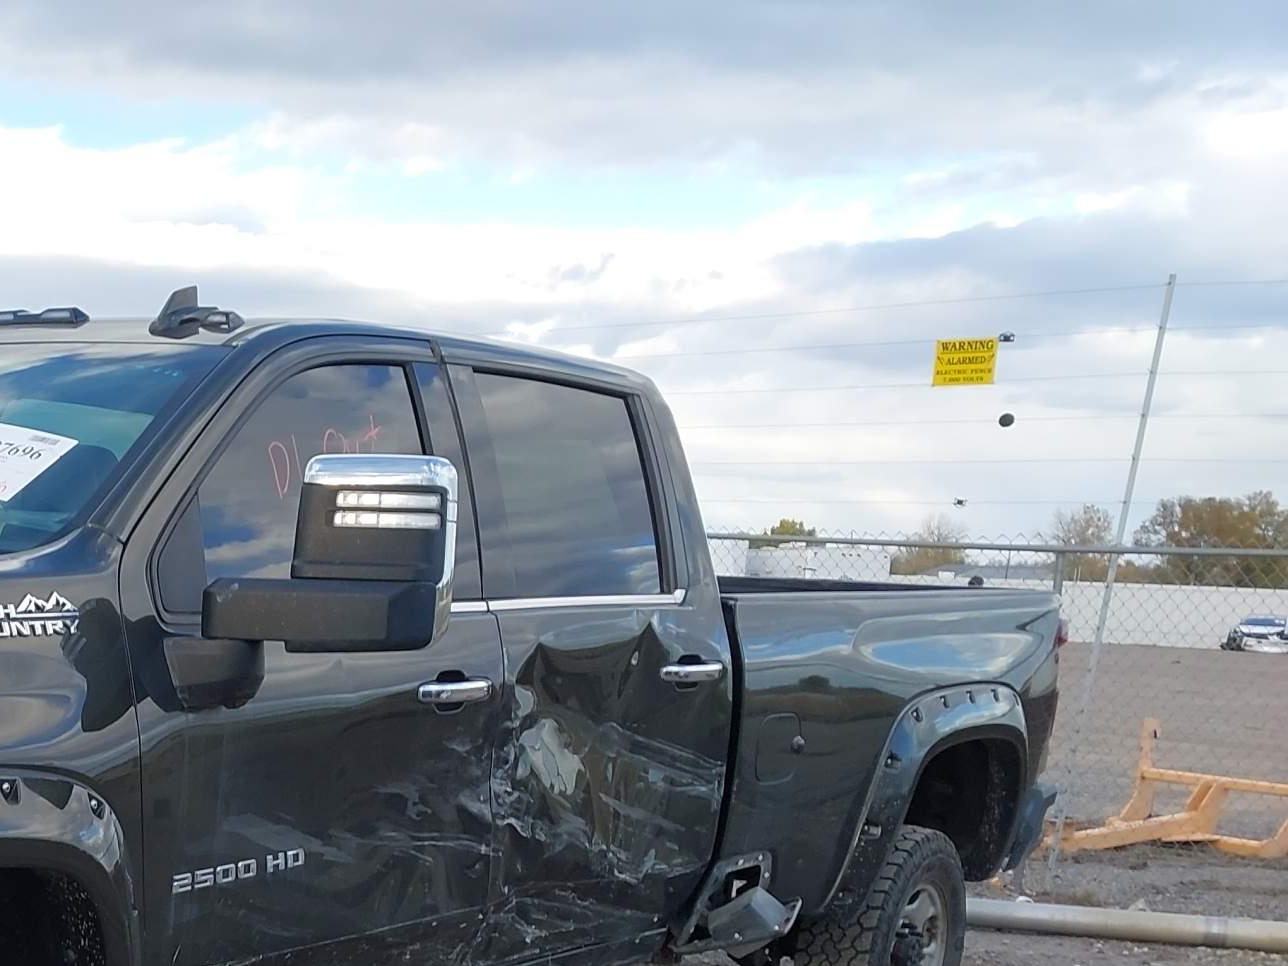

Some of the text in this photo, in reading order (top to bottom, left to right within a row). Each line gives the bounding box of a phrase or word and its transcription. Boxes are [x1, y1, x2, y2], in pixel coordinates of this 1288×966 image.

[941, 340, 994, 352] WARNING
[946, 355, 986, 366] ALARMED
[172, 848, 305, 895] 2500 HD
